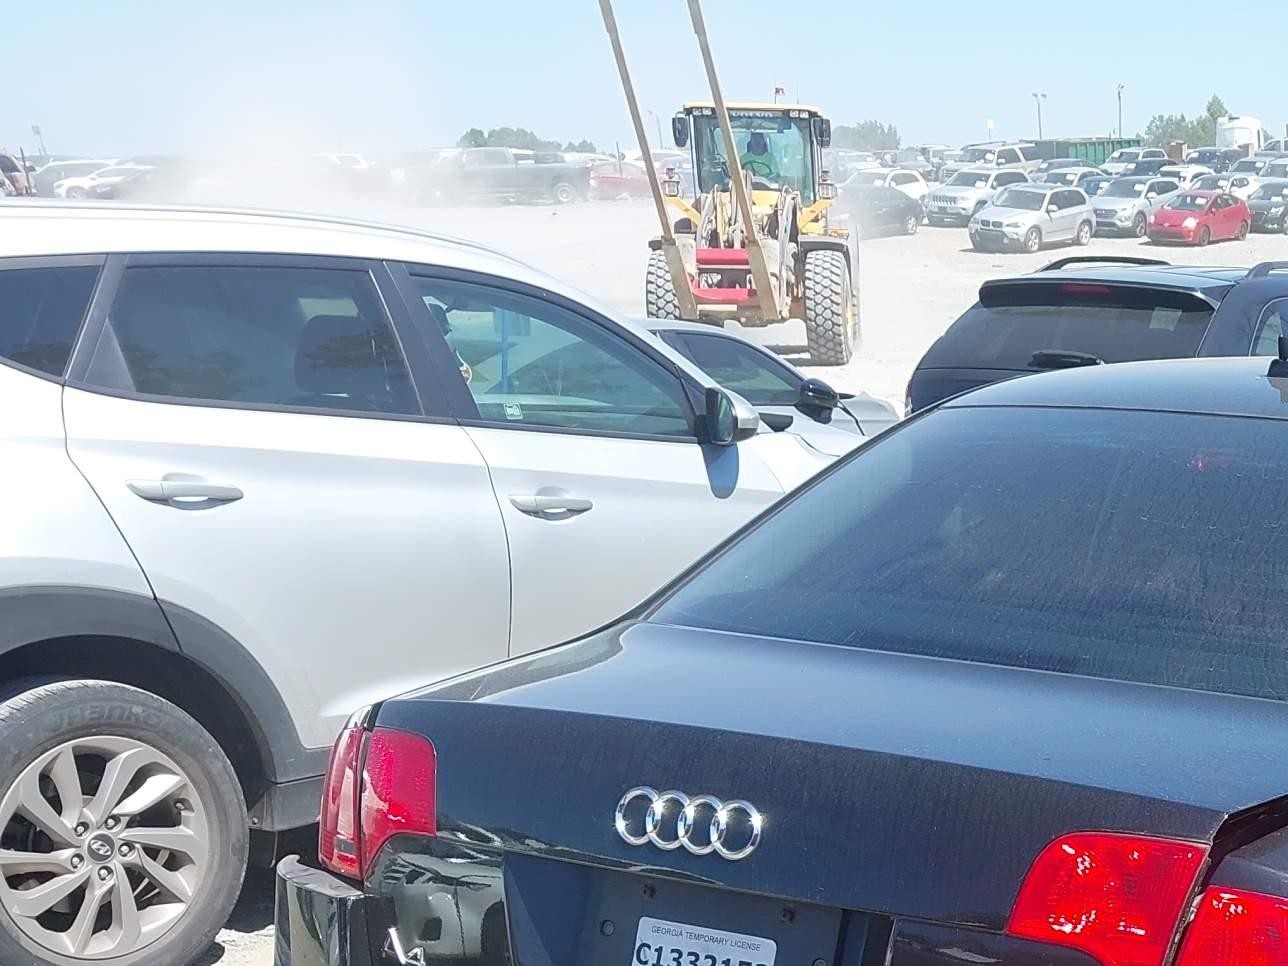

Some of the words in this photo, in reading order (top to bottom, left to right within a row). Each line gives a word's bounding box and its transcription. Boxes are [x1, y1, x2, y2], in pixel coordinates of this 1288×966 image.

[651, 925, 683, 940] GEORGIA
[685, 931, 729, 946] TEMPORARY
[730, 939, 761, 952] LICENSE
